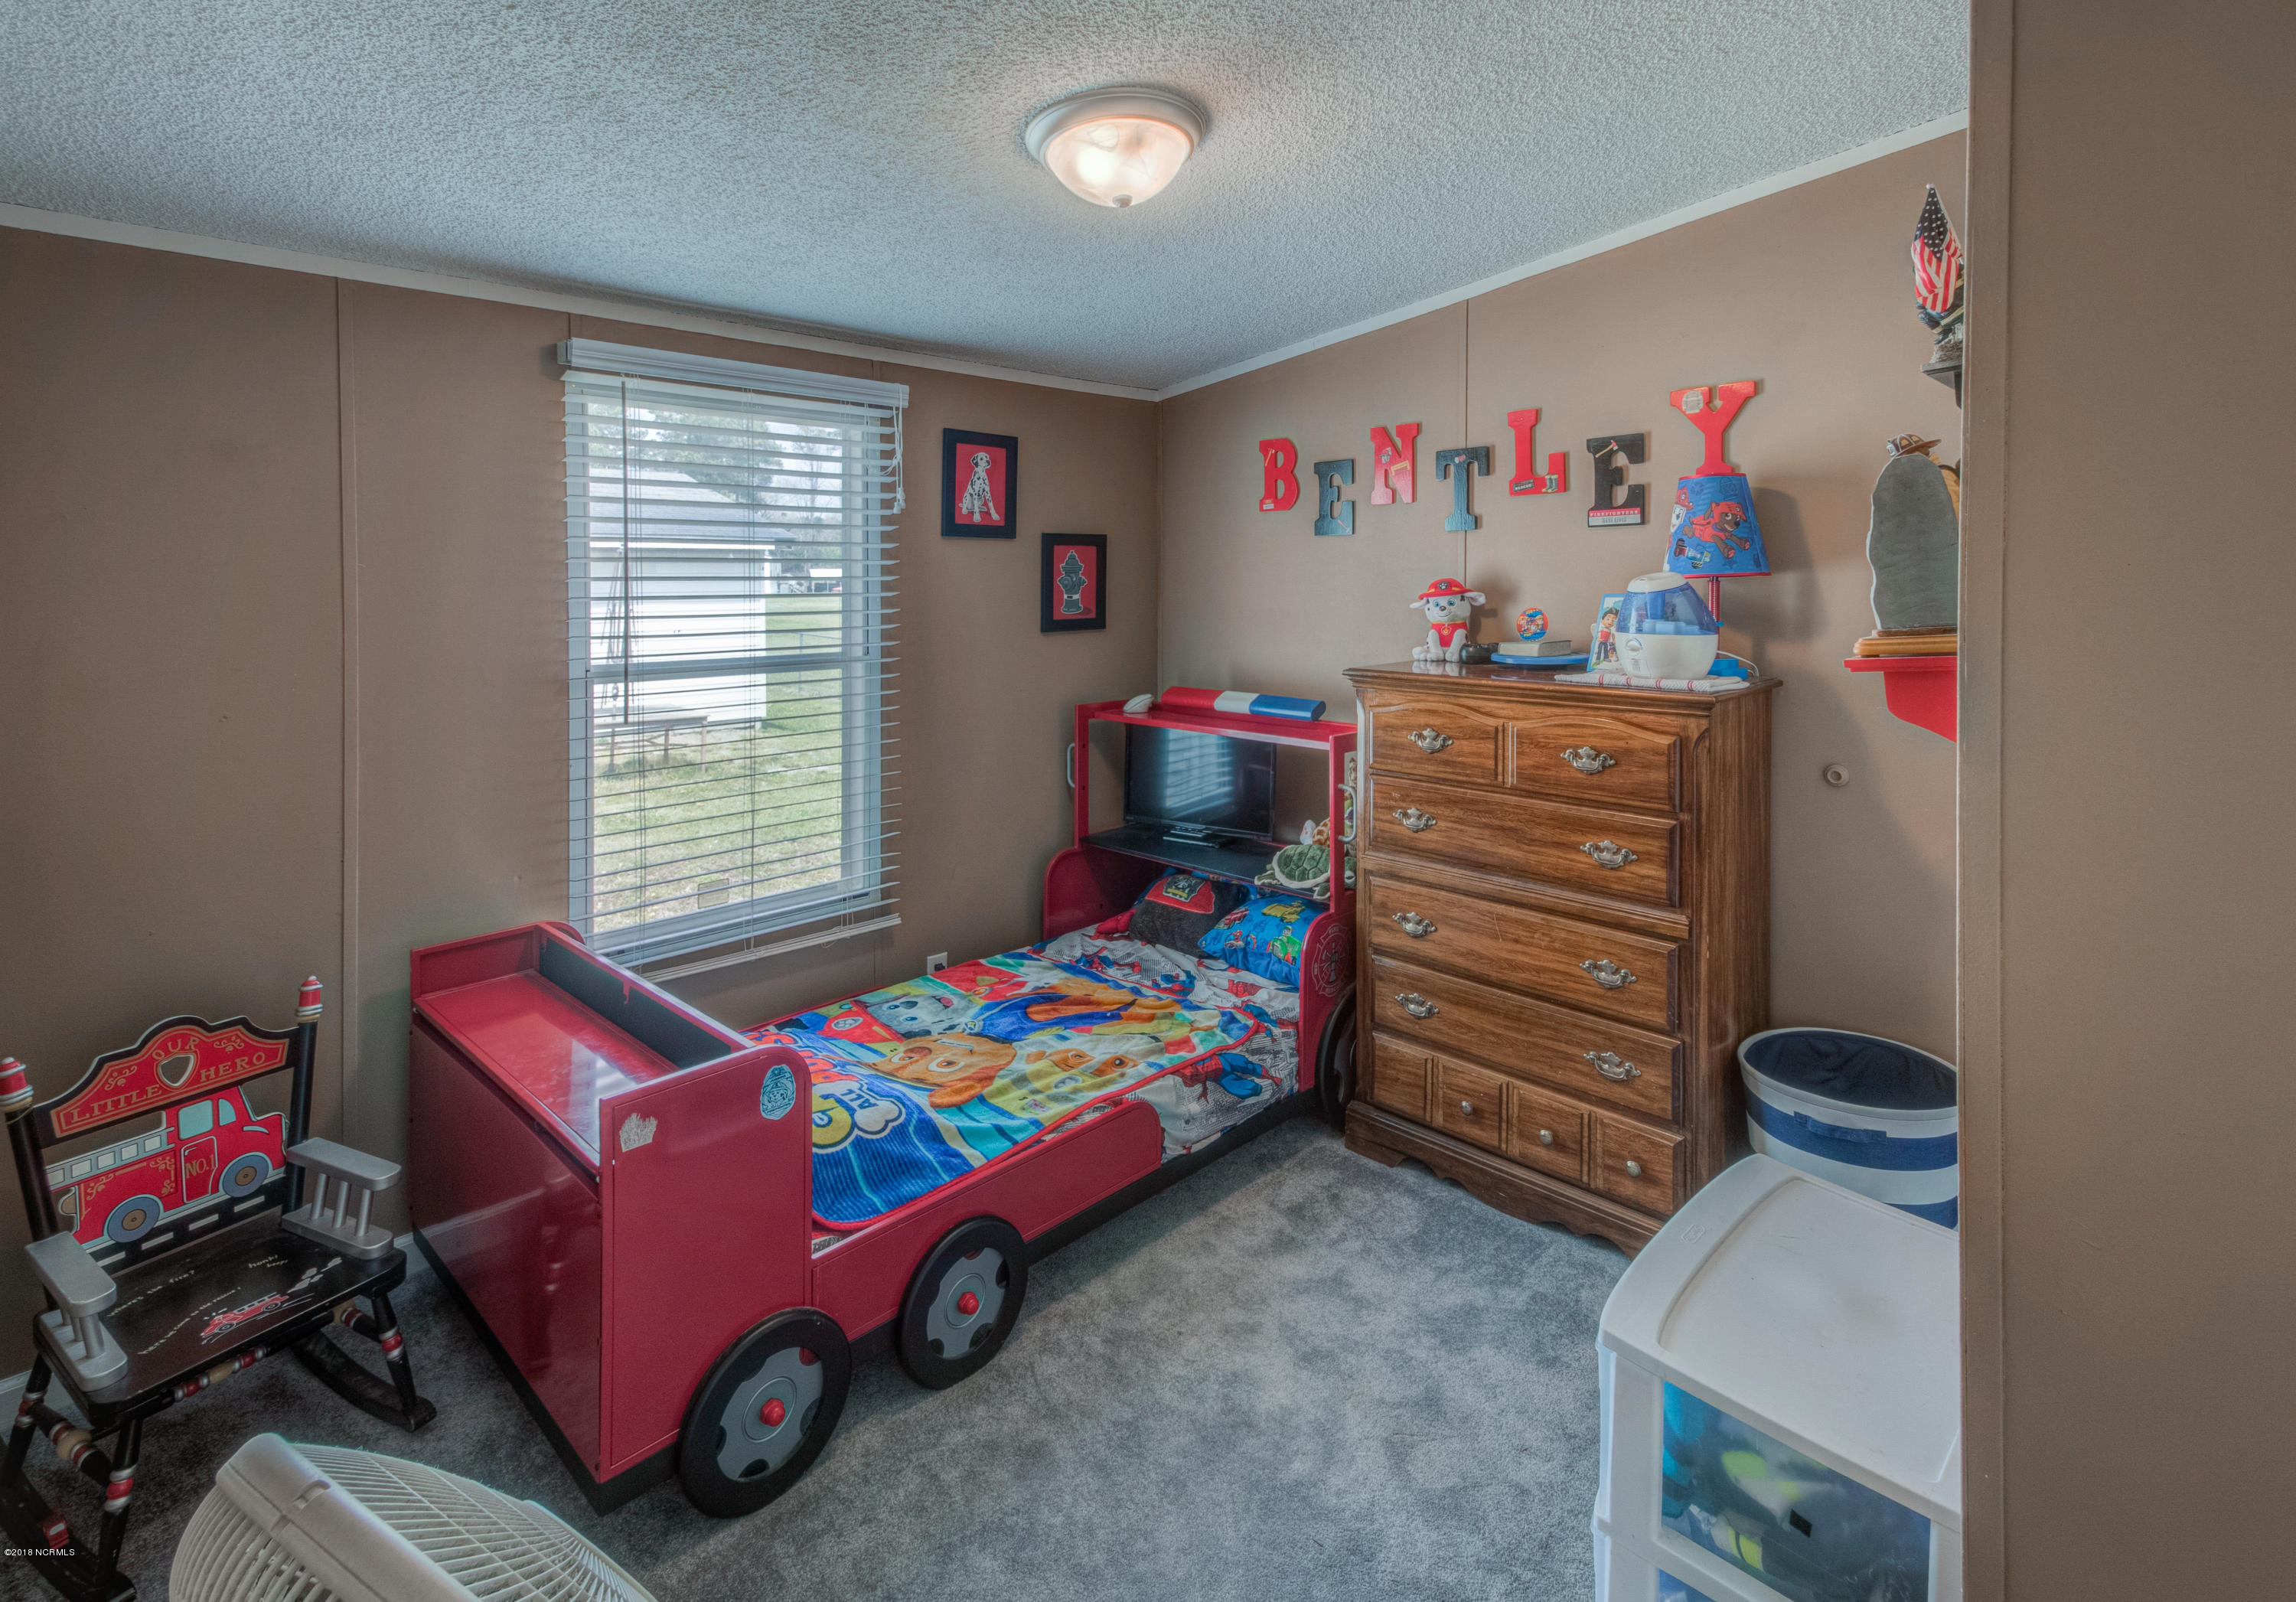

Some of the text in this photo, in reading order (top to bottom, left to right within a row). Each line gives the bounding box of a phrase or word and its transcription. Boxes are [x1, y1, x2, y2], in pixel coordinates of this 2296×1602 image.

[1259, 380, 1756, 536] BENTLEY
[152, 1036, 199, 1061] OUR
[69, 1051, 266, 1124] LITTLE HERO
[840, 1088, 879, 1110] ALL
[185, 1154, 215, 1178] NO.1
